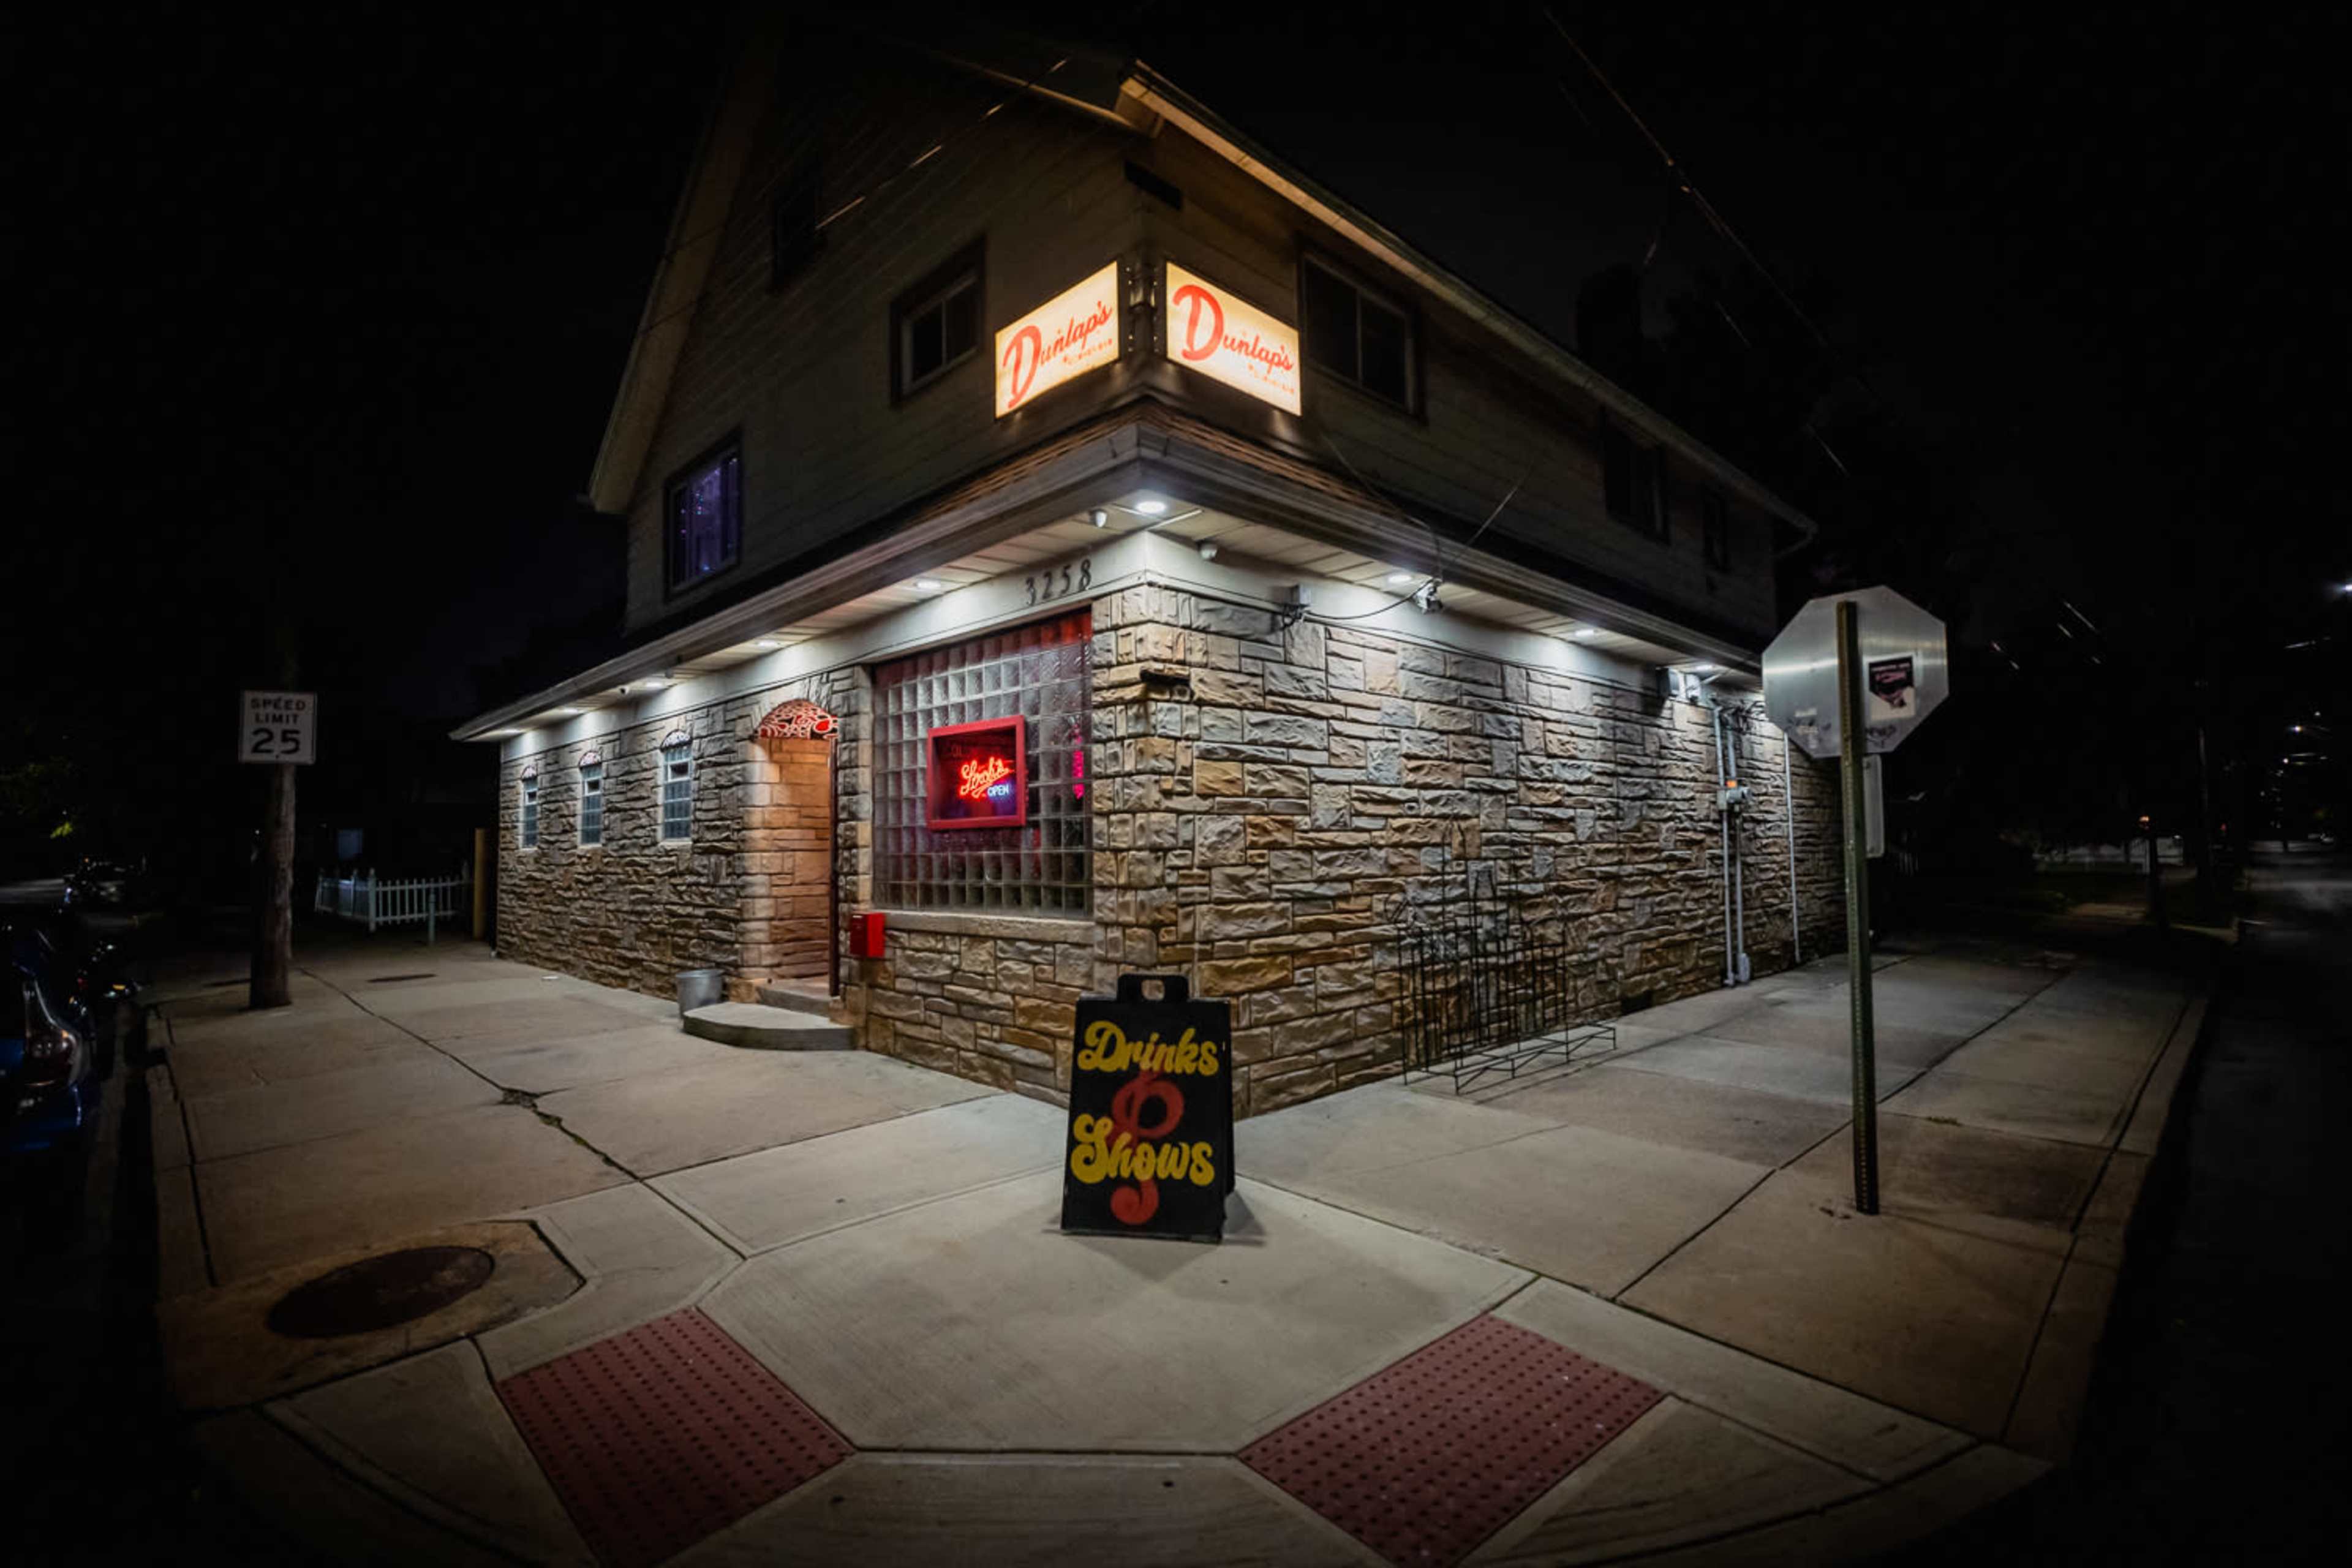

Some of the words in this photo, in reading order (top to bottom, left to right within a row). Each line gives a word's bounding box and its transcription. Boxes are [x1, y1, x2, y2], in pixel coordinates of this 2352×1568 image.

[1172, 284, 1292, 374] Dunlap's
[1002, 301, 1112, 409] Dunlap's
[1026, 559, 1091, 606] 3258
[251, 699, 305, 710] SPEED
[255, 713, 299, 724] LIMIT
[251, 728, 300, 754] 25
[987, 784, 1009, 797] OPEN
[1077, 1020, 1219, 1076] Drinks
[1071, 1113, 1215, 1186] Shows
